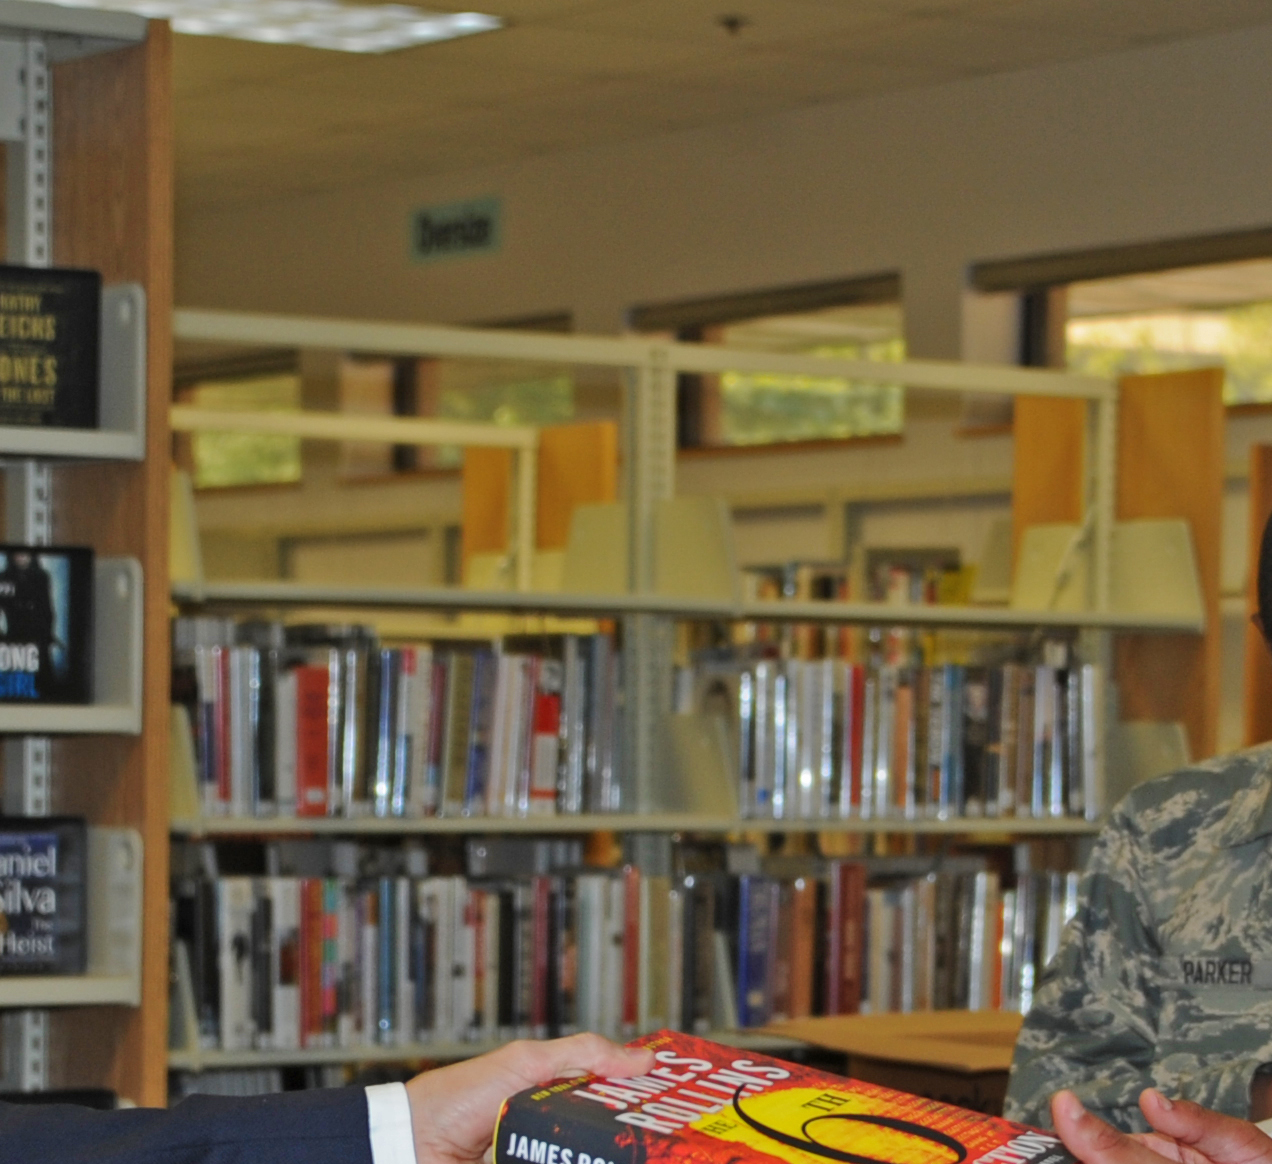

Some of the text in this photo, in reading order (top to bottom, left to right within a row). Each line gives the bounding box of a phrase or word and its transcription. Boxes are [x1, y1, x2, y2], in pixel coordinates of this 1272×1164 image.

[1183, 960, 1252, 984] PARKER
[572, 1050, 713, 1110] JAMES
[614, 1059, 790, 1135] ROLLINS
